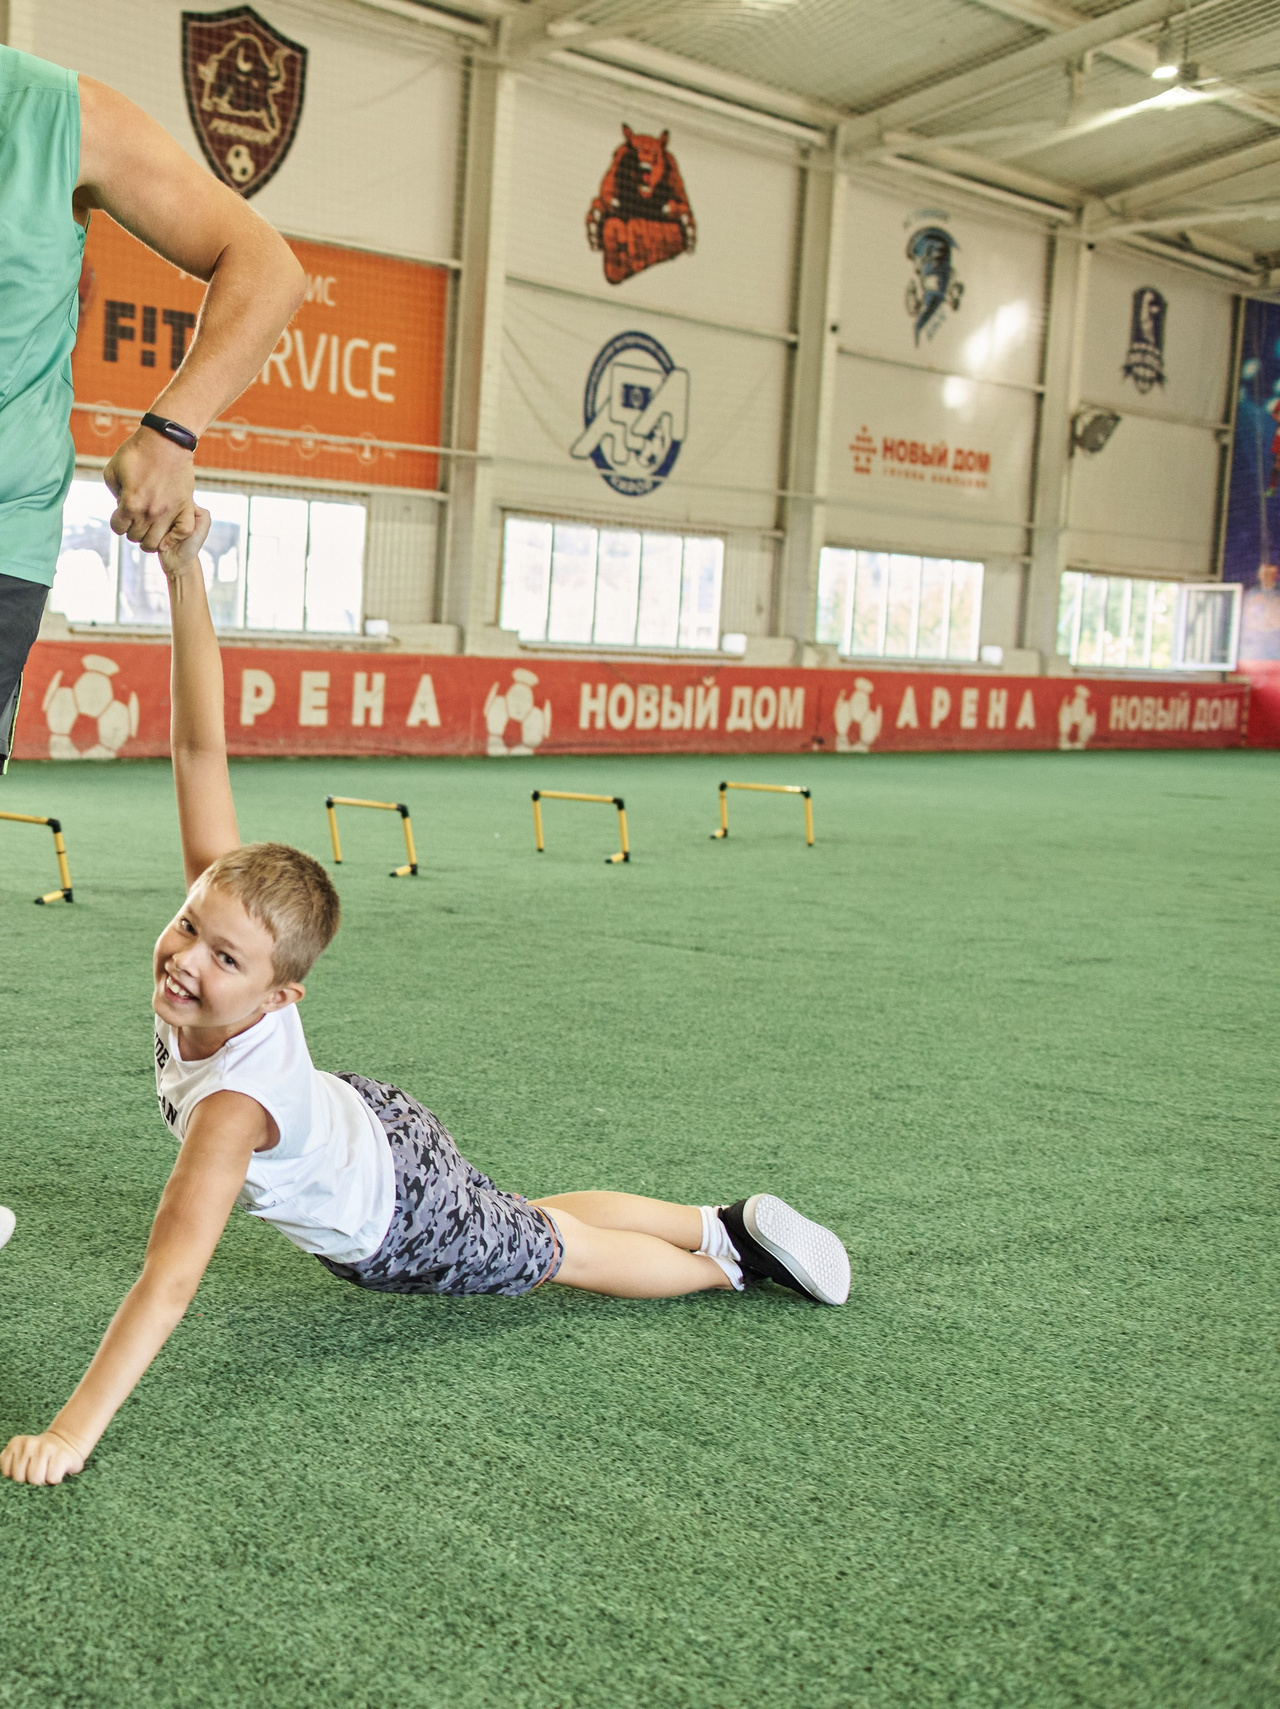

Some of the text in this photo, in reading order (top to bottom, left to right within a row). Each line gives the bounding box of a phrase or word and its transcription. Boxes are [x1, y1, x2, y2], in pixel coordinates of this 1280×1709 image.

[252, 326, 397, 403] RVICE
[882, 436, 991, 474] НОВЫЙ ДОМ
[239, 669, 442, 728] РЕНА
[578, 676, 805, 733] НОВЫЙ ДОМ
[895, 685, 1036, 730] АРЕНА
[1108, 691, 1239, 733] НОВЫЙ ДОМ
